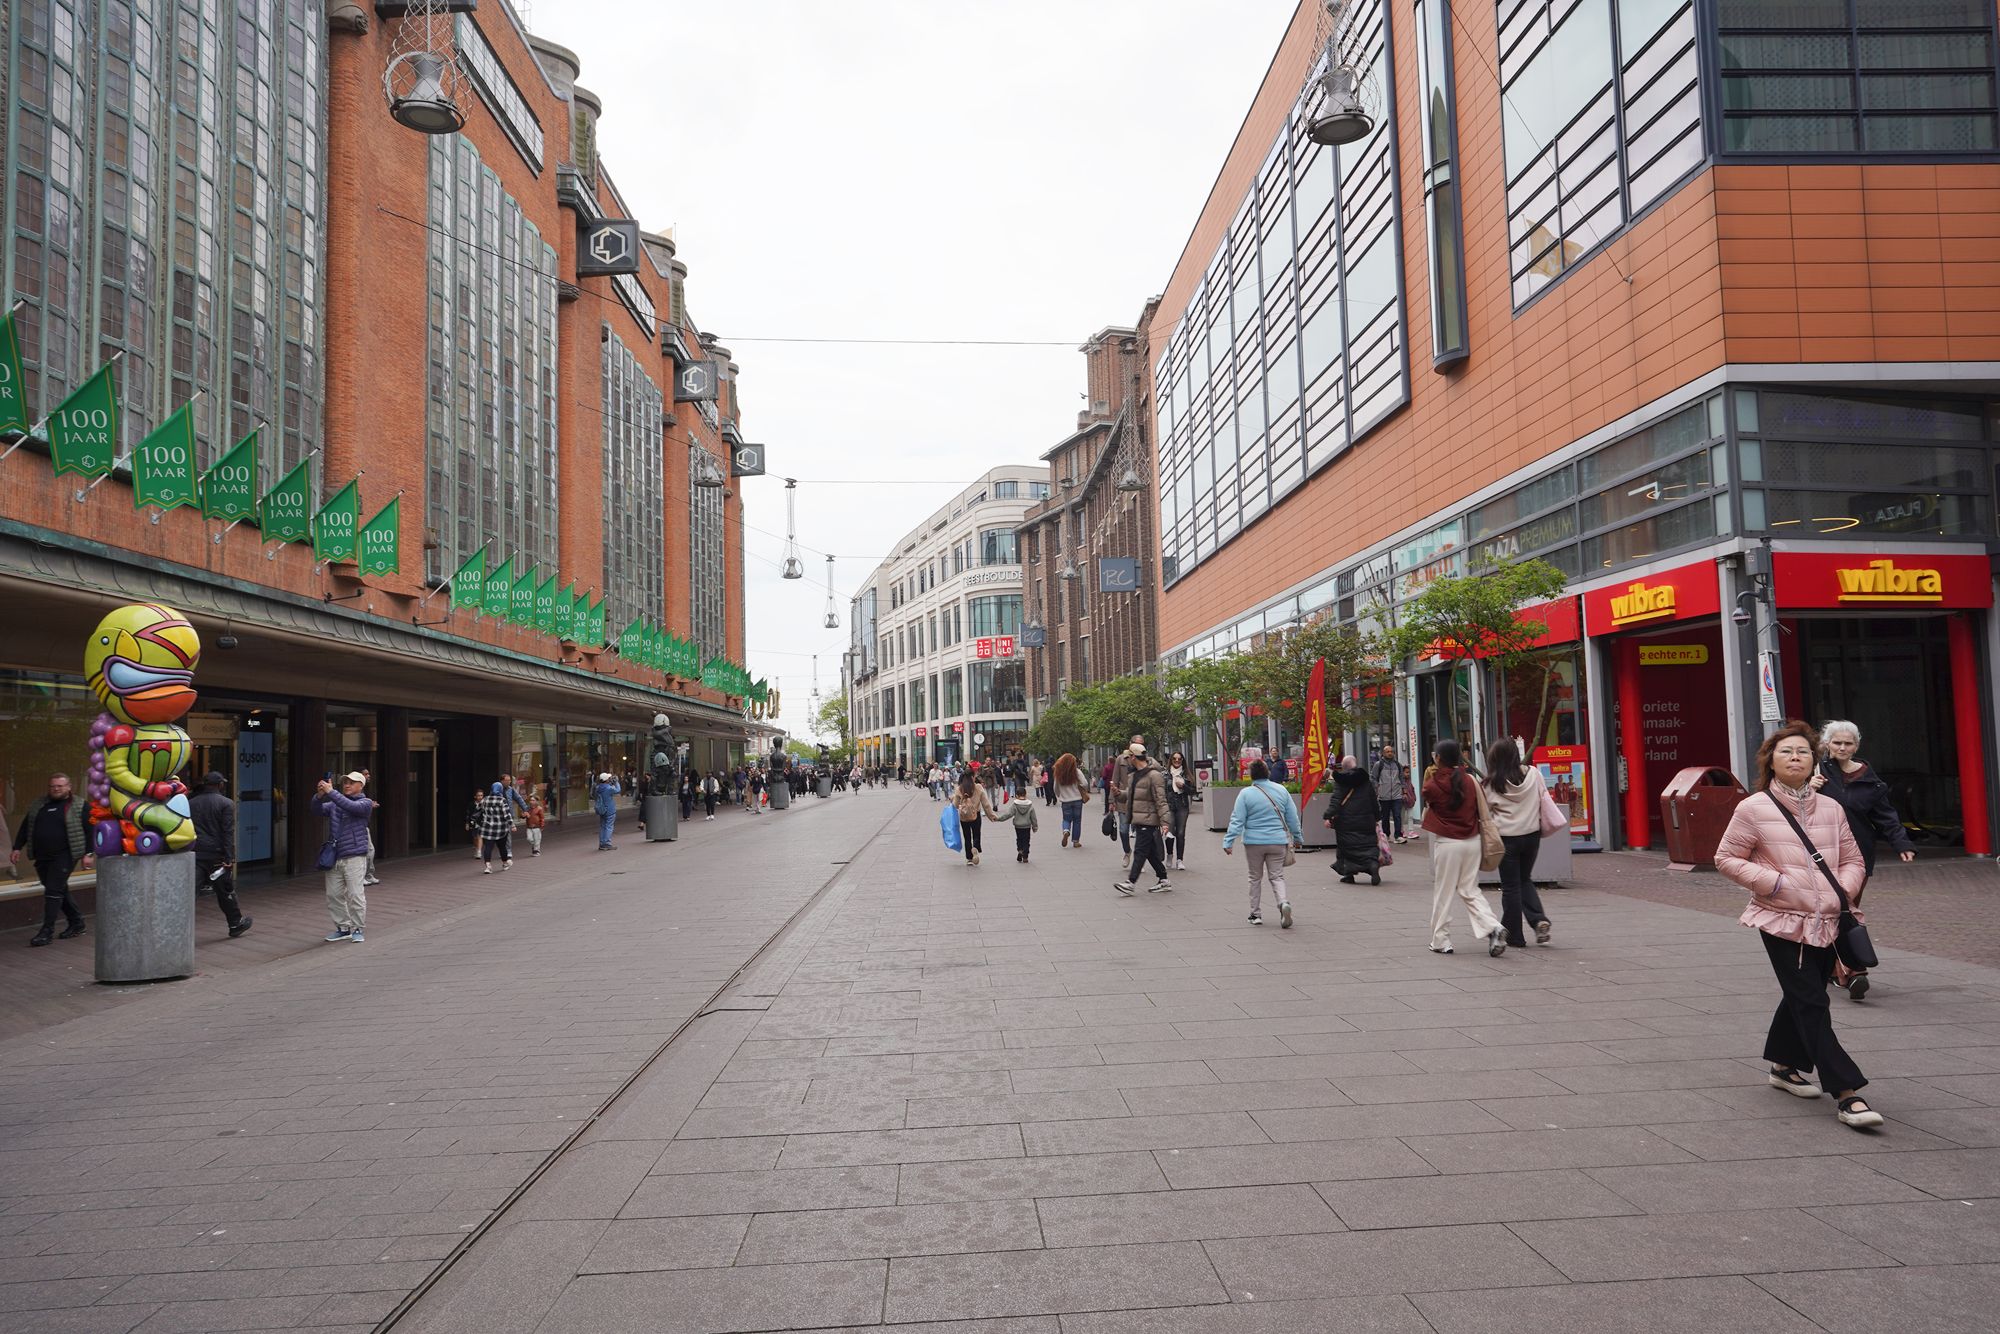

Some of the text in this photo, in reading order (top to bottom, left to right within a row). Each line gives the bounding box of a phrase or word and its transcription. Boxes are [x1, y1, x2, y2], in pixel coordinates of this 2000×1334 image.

[58, 409, 108, 428] 100
[64, 432, 108, 445] JAAR
[141, 446, 186, 465] 100
[145, 468, 186, 480] JAAR
[212, 465, 249, 482] 100
[213, 484, 249, 494] JAAR
[269, 491, 303, 507] 100
[270, 509, 303, 519] JAAR
[321, 512, 353, 526] 100
[323, 529, 353, 538] JAAR
[364, 529, 394, 544] 100
[1519, 516, 1574, 551] PREMIUM
[367, 545, 394, 554] JAAR
[458, 571, 481, 583] 100
[1836, 560, 1942, 593] wibra
[458, 583, 481, 591] JAAR
[486, 580, 509, 592] 100
[512, 590, 533, 601] 100
[1610, 583, 1675, 619] wibra
[537, 597, 553, 607] 00
[556, 604, 570, 614] 00
[624, 634, 640, 642] 100
[997, 638, 1011, 647] UNI
[997, 647, 1012, 656] QLO
[1648, 650, 1677, 660] echte
[1679, 651, 1693, 659] nr.
[1695, 649, 1701, 659] 1
[1307, 699, 1322, 774] wibra
[1656, 736, 1678, 744] van
[1547, 747, 1572, 756] wibra
[240, 748, 267, 768] dyson
[1552, 764, 1570, 772] wibra
